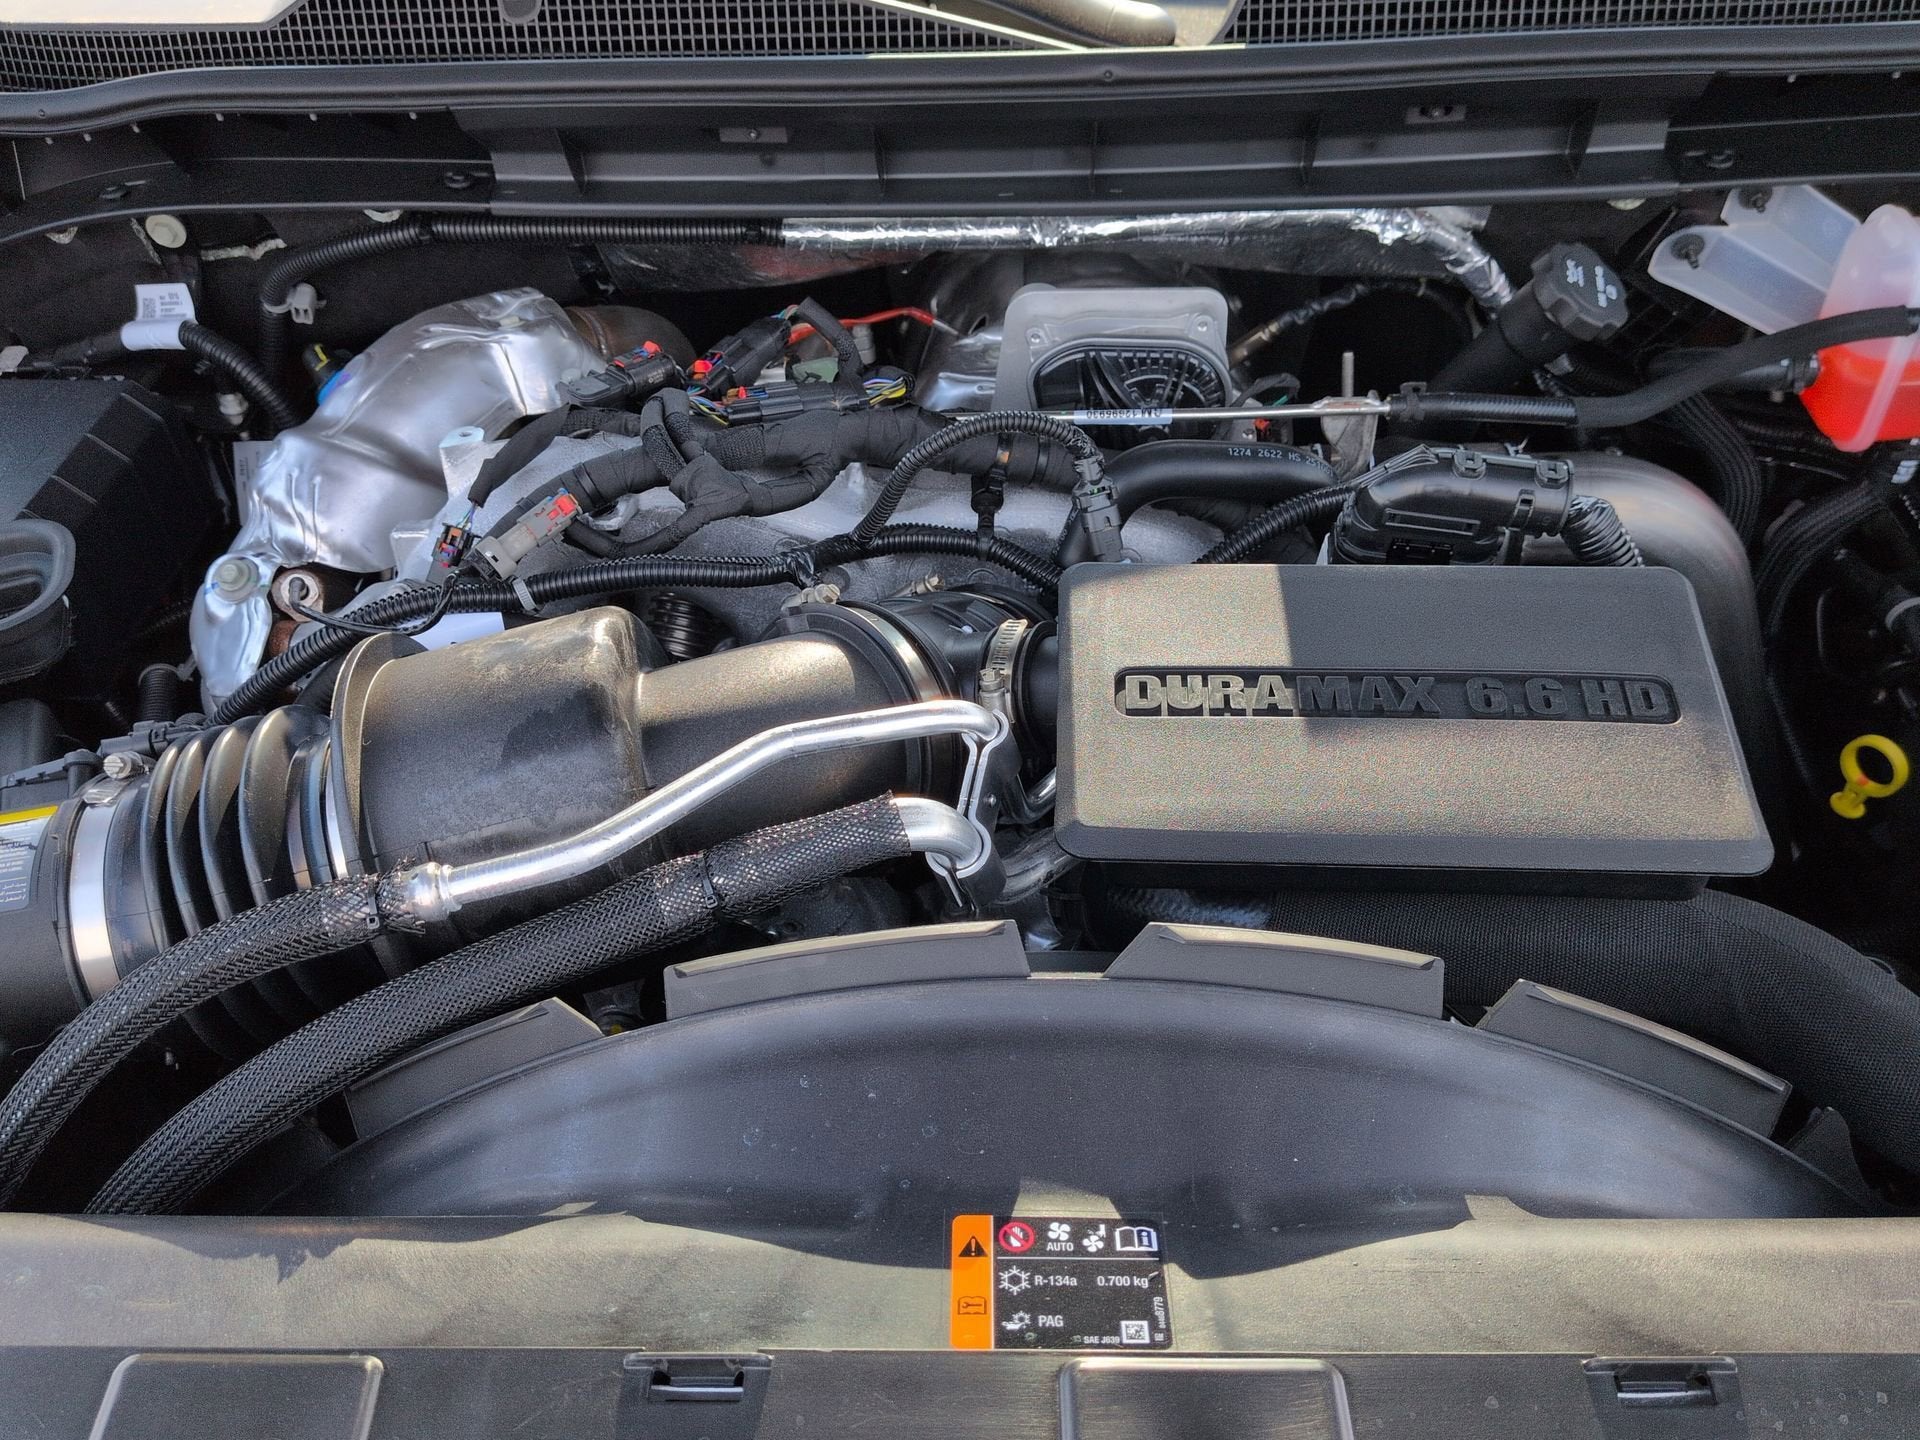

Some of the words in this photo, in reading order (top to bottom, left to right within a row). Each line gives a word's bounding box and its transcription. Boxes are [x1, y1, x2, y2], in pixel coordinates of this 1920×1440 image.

[1228, 447, 1251, 457] 1274
[1258, 448, 1282, 459] 2622
[1288, 452, 1302, 462] HS
[1125, 674, 1440, 716] DURAMAX
[1467, 677, 1567, 716] 6.6
[1580, 679, 1671, 718] HD
[1046, 1242, 1074, 1251] AUTO
[1034, 1275, 1077, 1286] R-134a
[1097, 1275, 1131, 1287] 0.700
[1133, 1275, 1149, 1288] kg
[1038, 1315, 1064, 1327] PAG
[1083, 1335, 1100, 1344] SAE
[1101, 1335, 1120, 1344] J639
